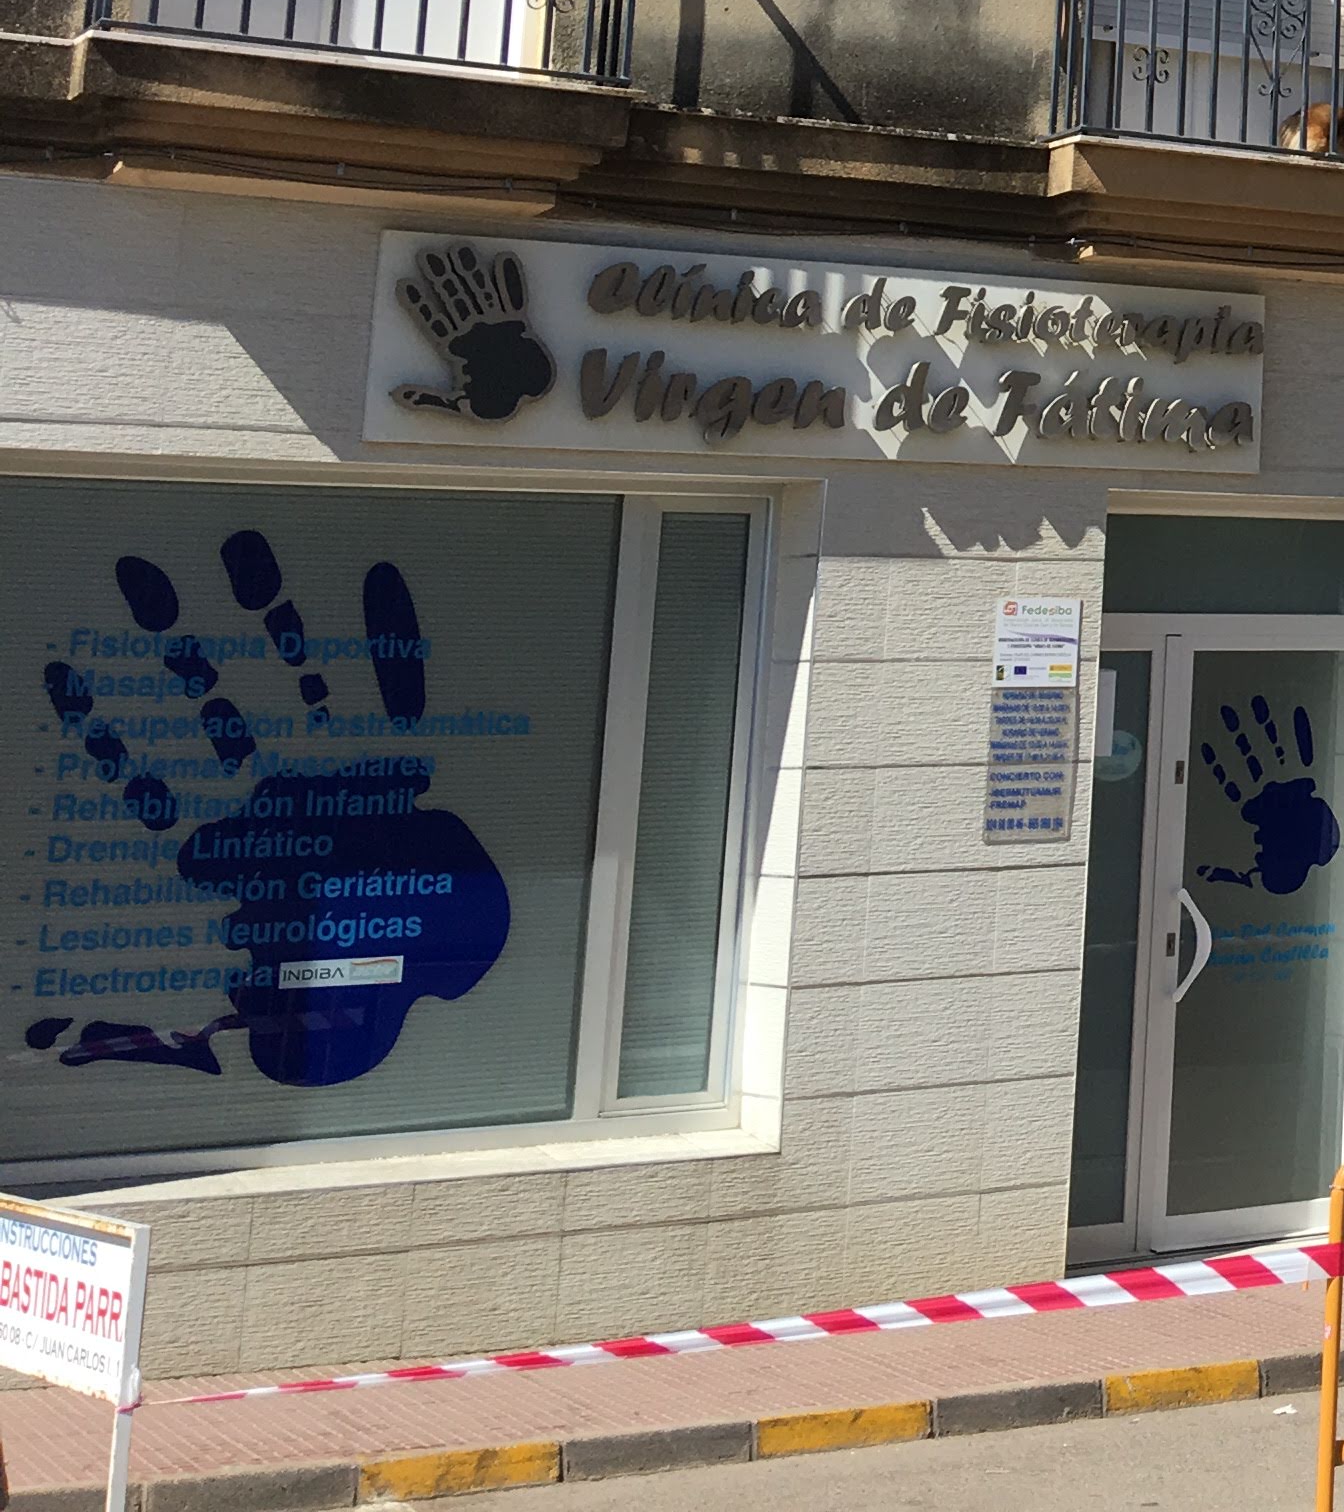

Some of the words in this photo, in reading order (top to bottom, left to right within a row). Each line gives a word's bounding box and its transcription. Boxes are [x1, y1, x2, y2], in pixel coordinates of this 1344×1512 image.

[587, 260, 822, 330] Clínica
[842, 276, 918, 334] de
[935, 284, 1265, 364] Fisioterapia
[578, 346, 849, 447] Virgen
[873, 361, 970, 435] de
[992, 370, 1256, 453] Fátima
[69, 626, 267, 665] Fisioterapia
[278, 630, 433, 665] Deportiva
[64, 666, 206, 705] Masajes
[60, 708, 294, 746] Recuperación
[306, 703, 531, 739] Postraumática
[56, 751, 240, 786] Problemas
[250, 751, 437, 781] Musculares
[52, 785, 294, 823] Rehabilitación
[306, 788, 416, 818] Infantil
[47, 832, 180, 869] Drenaje
[192, 828, 333, 863] Linfático
[42, 868, 286, 909] Rehabilitación
[298, 867, 454, 900] Geriátrica
[38, 918, 195, 954] Lesiones
[206, 913, 423, 951] Neurológicas
[35, 962, 274, 998] Electroterapia
[283, 967, 344, 982] INDIBA
[0, 1260, 68, 1326] BASTIDA
[72, 1281, 124, 1342] PARR
[40, 1335, 64, 1360] JUAN
[66, 1344, 106, 1374] CARLOS
